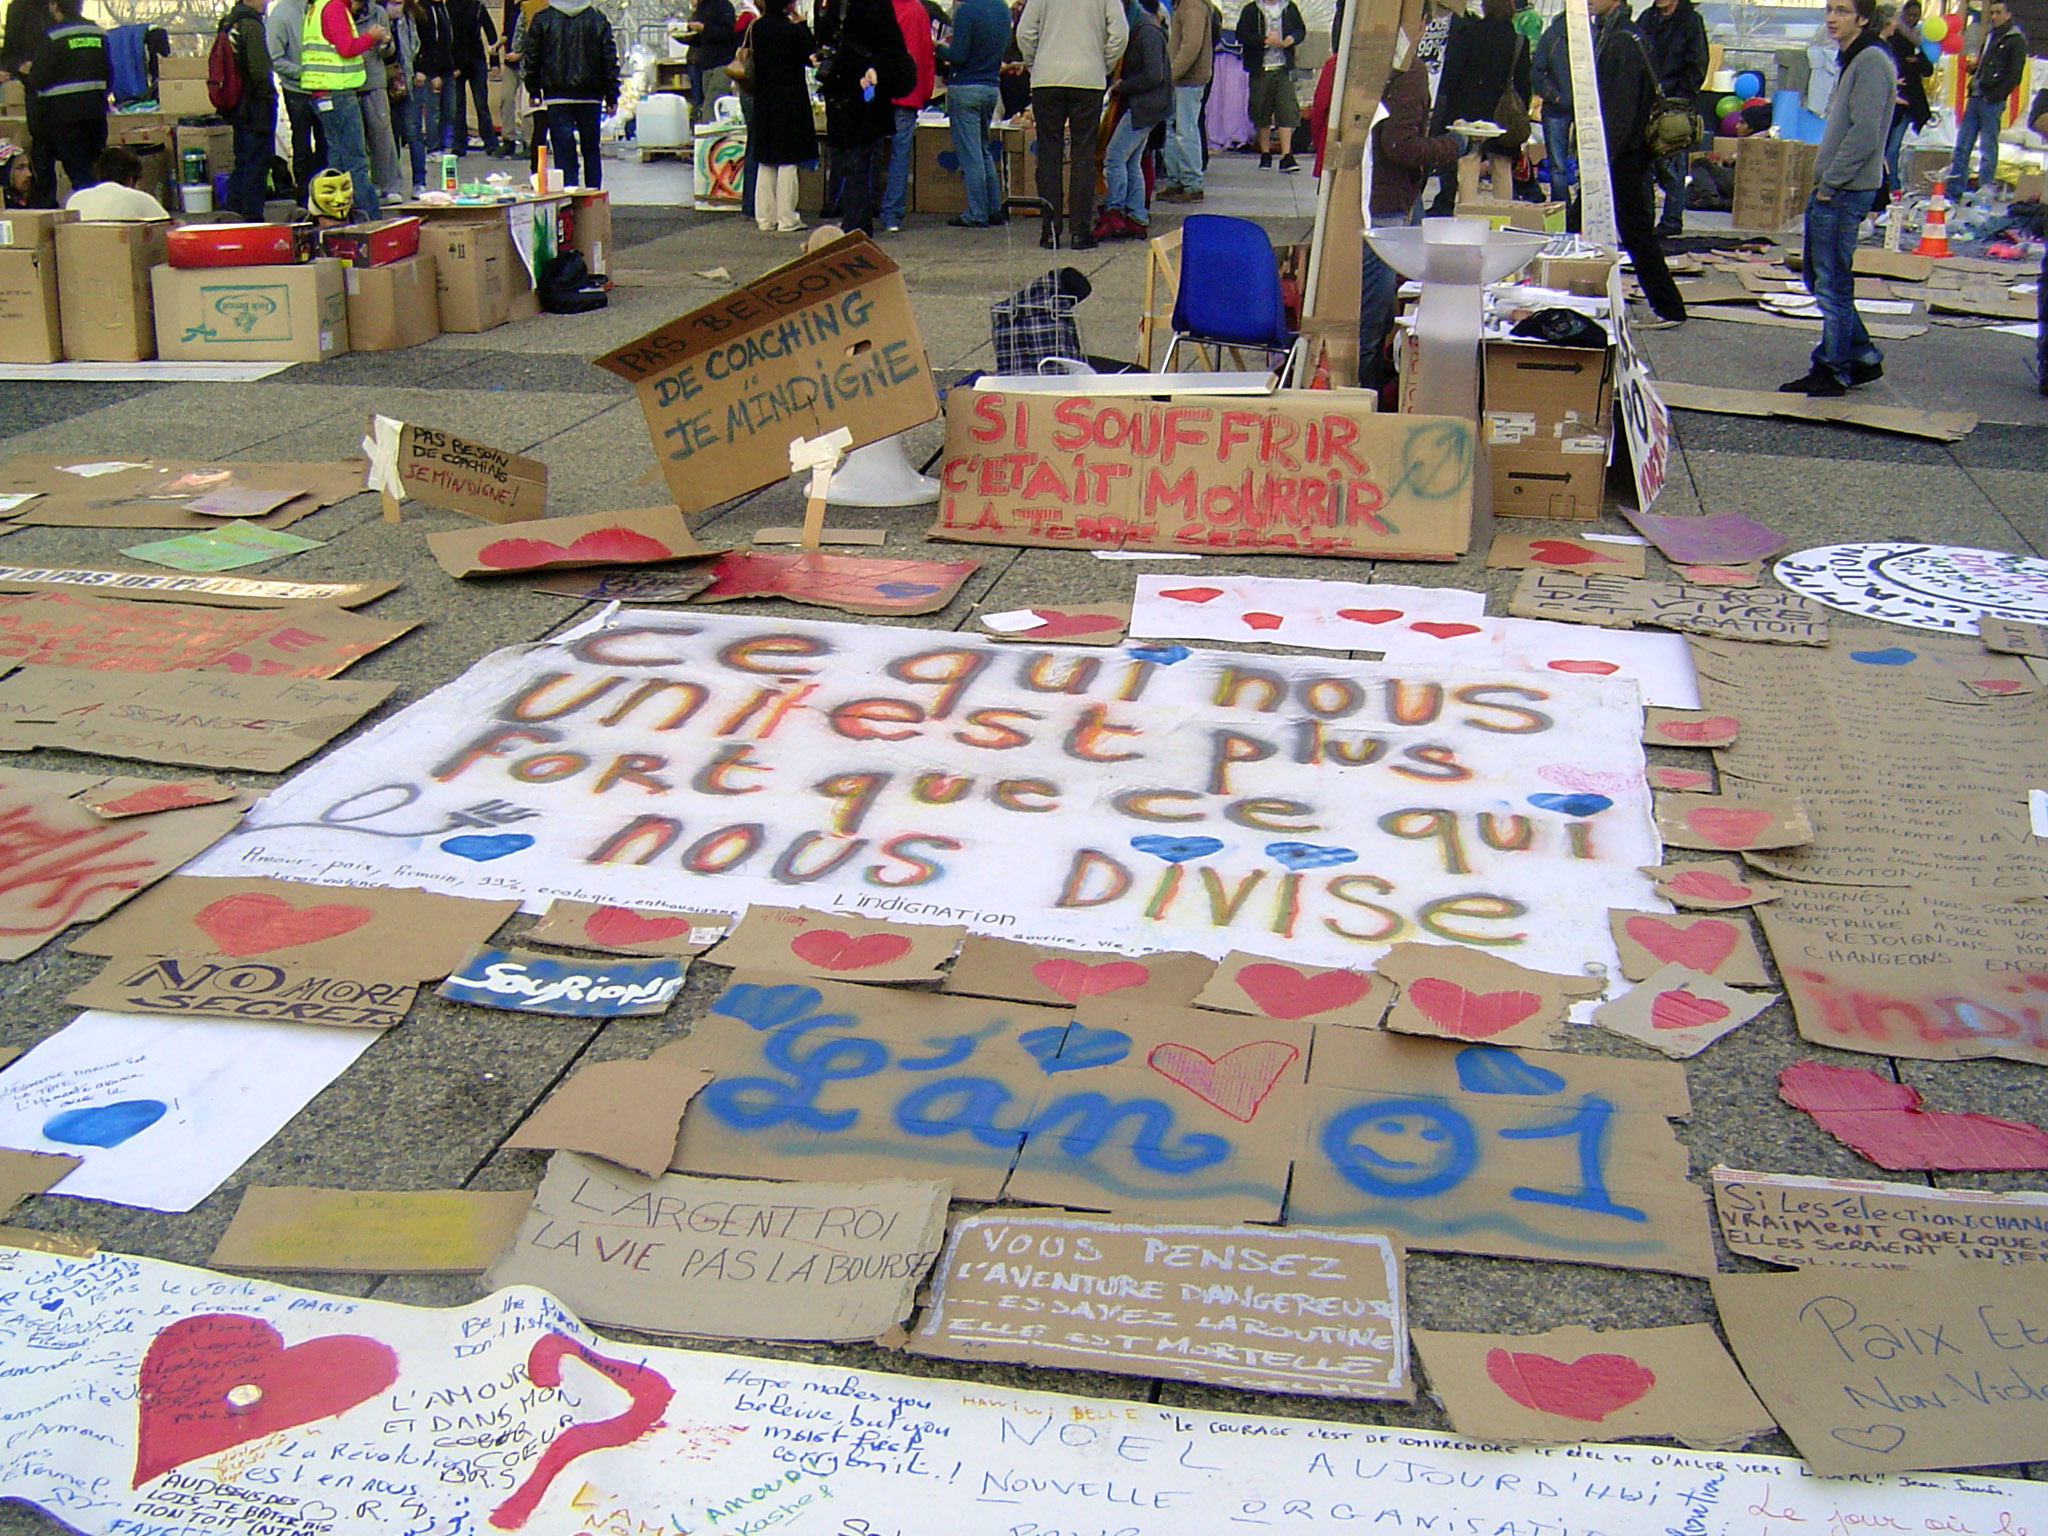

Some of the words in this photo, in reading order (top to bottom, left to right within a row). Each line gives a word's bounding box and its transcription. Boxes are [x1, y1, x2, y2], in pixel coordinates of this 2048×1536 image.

[614, 335, 687, 375] PAS
[692, 253, 881, 332] BESOIN
[653, 364, 704, 409] DE
[704, 290, 875, 381] COACHING
[413, 427, 446, 448] PAS
[451, 438, 509, 468] BESOIN
[664, 409, 722, 461] JE
[968, 394, 1028, 449] SI
[1050, 396, 1371, 471] SOUFFRIR
[403, 463, 430, 483] JE
[413, 445, 438, 459] DE
[441, 453, 508, 483] COACHING
[1143, 463, 1390, 535] MOURRIR
[50, 569, 113, 585] PAS
[117, 576, 165, 588] DE
[1537, 575, 1631, 595] LE
[1532, 589, 1624, 604] DE
[1650, 597, 1813, 621] VIVRE
[886, 648, 1159, 721] qui
[1215, 666, 1555, 734] nous
[827, 697, 1146, 763] est
[1207, 719, 1473, 794] plus
[810, 768, 1063, 837] que
[1113, 787, 1324, 834] ce
[1375, 806, 1594, 875] qui
[585, 811, 964, 889] nous
[1774, 911, 1904, 931] CONSTRUIRE
[1933, 921, 1991, 938] AVEC
[1801, 945, 1952, 967] CHANGEONS
[118, 957, 288, 995] NO
[275, 977, 421, 1007] MORE
[126, 993, 408, 1027] SECRETS
[570, 1177, 817, 1240] L'ARGENT
[813, 1205, 900, 1242] ROI
[1723, 1181, 1767, 1212] Si
[531, 1220, 580, 1258] LA
[594, 1234, 666, 1271] VIE
[681, 1247, 759, 1281] PAS
[765, 1250, 820, 1285] LA
[824, 1250, 938, 1286] BOURSE
[982, 1226, 1104, 1262] VOUS
[1143, 1236, 1348, 1281] PENSEZ
[1726, 1228, 1806, 1251] ELLES
[1810, 1238, 1942, 1257] SERAIENT
[1897, 1226, 2038, 1250] QUELQUE
[955, 1262, 1166, 1301] L'AVENTURE
[287, 1298, 360, 1314] PARIS
[1799, 1294, 1965, 1364] Paix
[1064, 1332, 1152, 1352] EST
[1154, 1336, 1385, 1375] MORTELLE
[391, 1363, 531, 1411] L'AMOUR
[723, 1367, 791, 1397] Hope
[803, 1374, 882, 1403] makes
[886, 1394, 933, 1418] you
[429, 1401, 513, 1434] DANS
[519, 1385, 582, 1414] MON
[1071, 1405, 1139, 1421] BELLE
[277, 1441, 318, 1459] La
[901, 1418, 952, 1448] you
[1209, 1420, 1293, 1438] COURAGE
[1307, 1428, 1354, 1441] C'EST
[1366, 1433, 1391, 1445] DE
[1398, 1436, 1520, 1456] COMPRENDRE
[1535, 1447, 1552, 1458] LE
[1613, 1454, 1633, 1463] ET
[1650, 1453, 1730, 1473] D'ALLER
[1735, 1463, 1782, 1476] VERS
[244, 1464, 306, 1485] est
[317, 1472, 355, 1488] en
[981, 1469, 1192, 1509] NOUVELLE
[1308, 1452, 1661, 1506] AUJOURD'HUI
[133, 1501, 186, 1520] MON
[203, 1498, 243, 1515] JE
[1747, 1481, 1808, 1523] Le
[1830, 1502, 1914, 1535] jour
[1924, 1512, 1976, 1534] où
